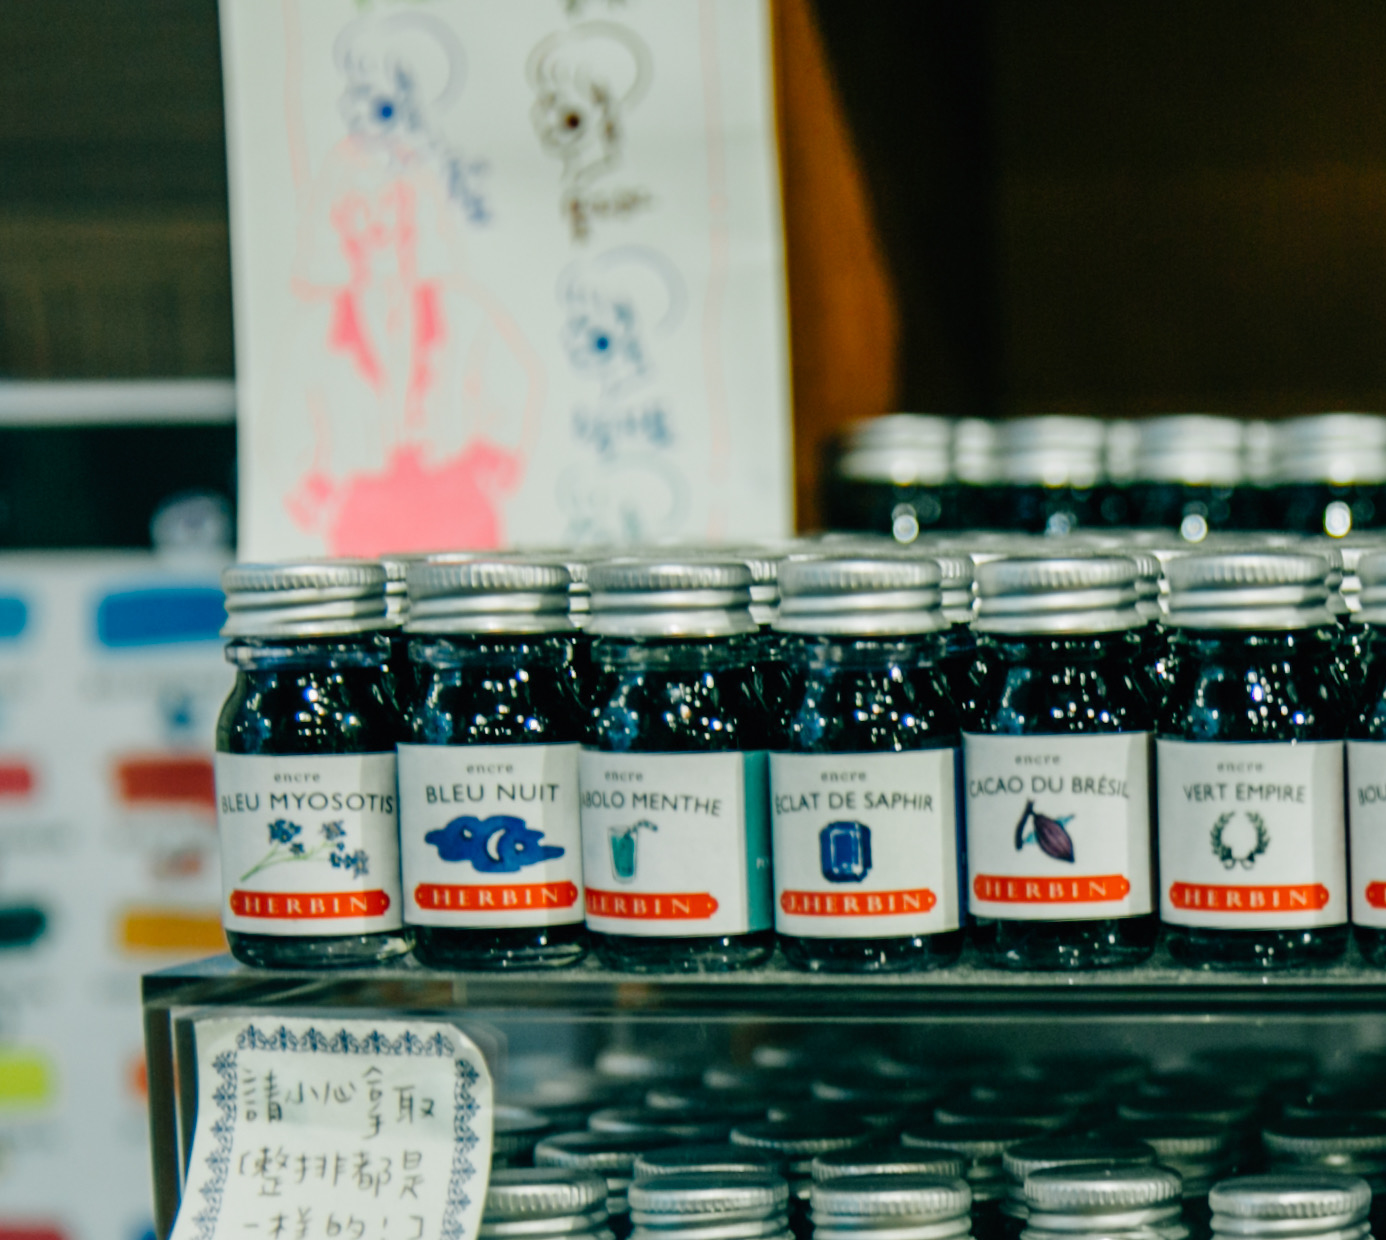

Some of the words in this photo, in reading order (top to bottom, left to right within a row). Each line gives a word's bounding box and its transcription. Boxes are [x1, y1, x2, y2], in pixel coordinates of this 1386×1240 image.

[465, 762, 514, 775] encre
[1014, 754, 1060, 767] encre
[1217, 760, 1264, 773] encre
[273, 772, 321, 784] encre
[820, 770, 867, 783] encre
[969, 776, 1023, 799] CACAO
[1030, 776, 1064, 794] DU
[1071, 773, 1131, 800] BRÉSIL
[424, 783, 485, 803] BLEU
[497, 783, 561, 802] NUIT
[828, 791, 856, 809] DE
[864, 792, 934, 813] SAPHIR
[1183, 783, 1227, 803] VERT
[1235, 783, 1307, 804] EMPIRE
[222, 794, 260, 814] BLEU
[270, 792, 395, 815] MYOSOTIS
[631, 792, 723, 816] MENTHE
[431, 886, 559, 908] HERBIN
[984, 880, 1108, 899] HERBIN
[1183, 888, 1309, 908] HERBIN
[244, 896, 369, 915] HERBIN
[786, 893, 922, 915] J.HERBIN
